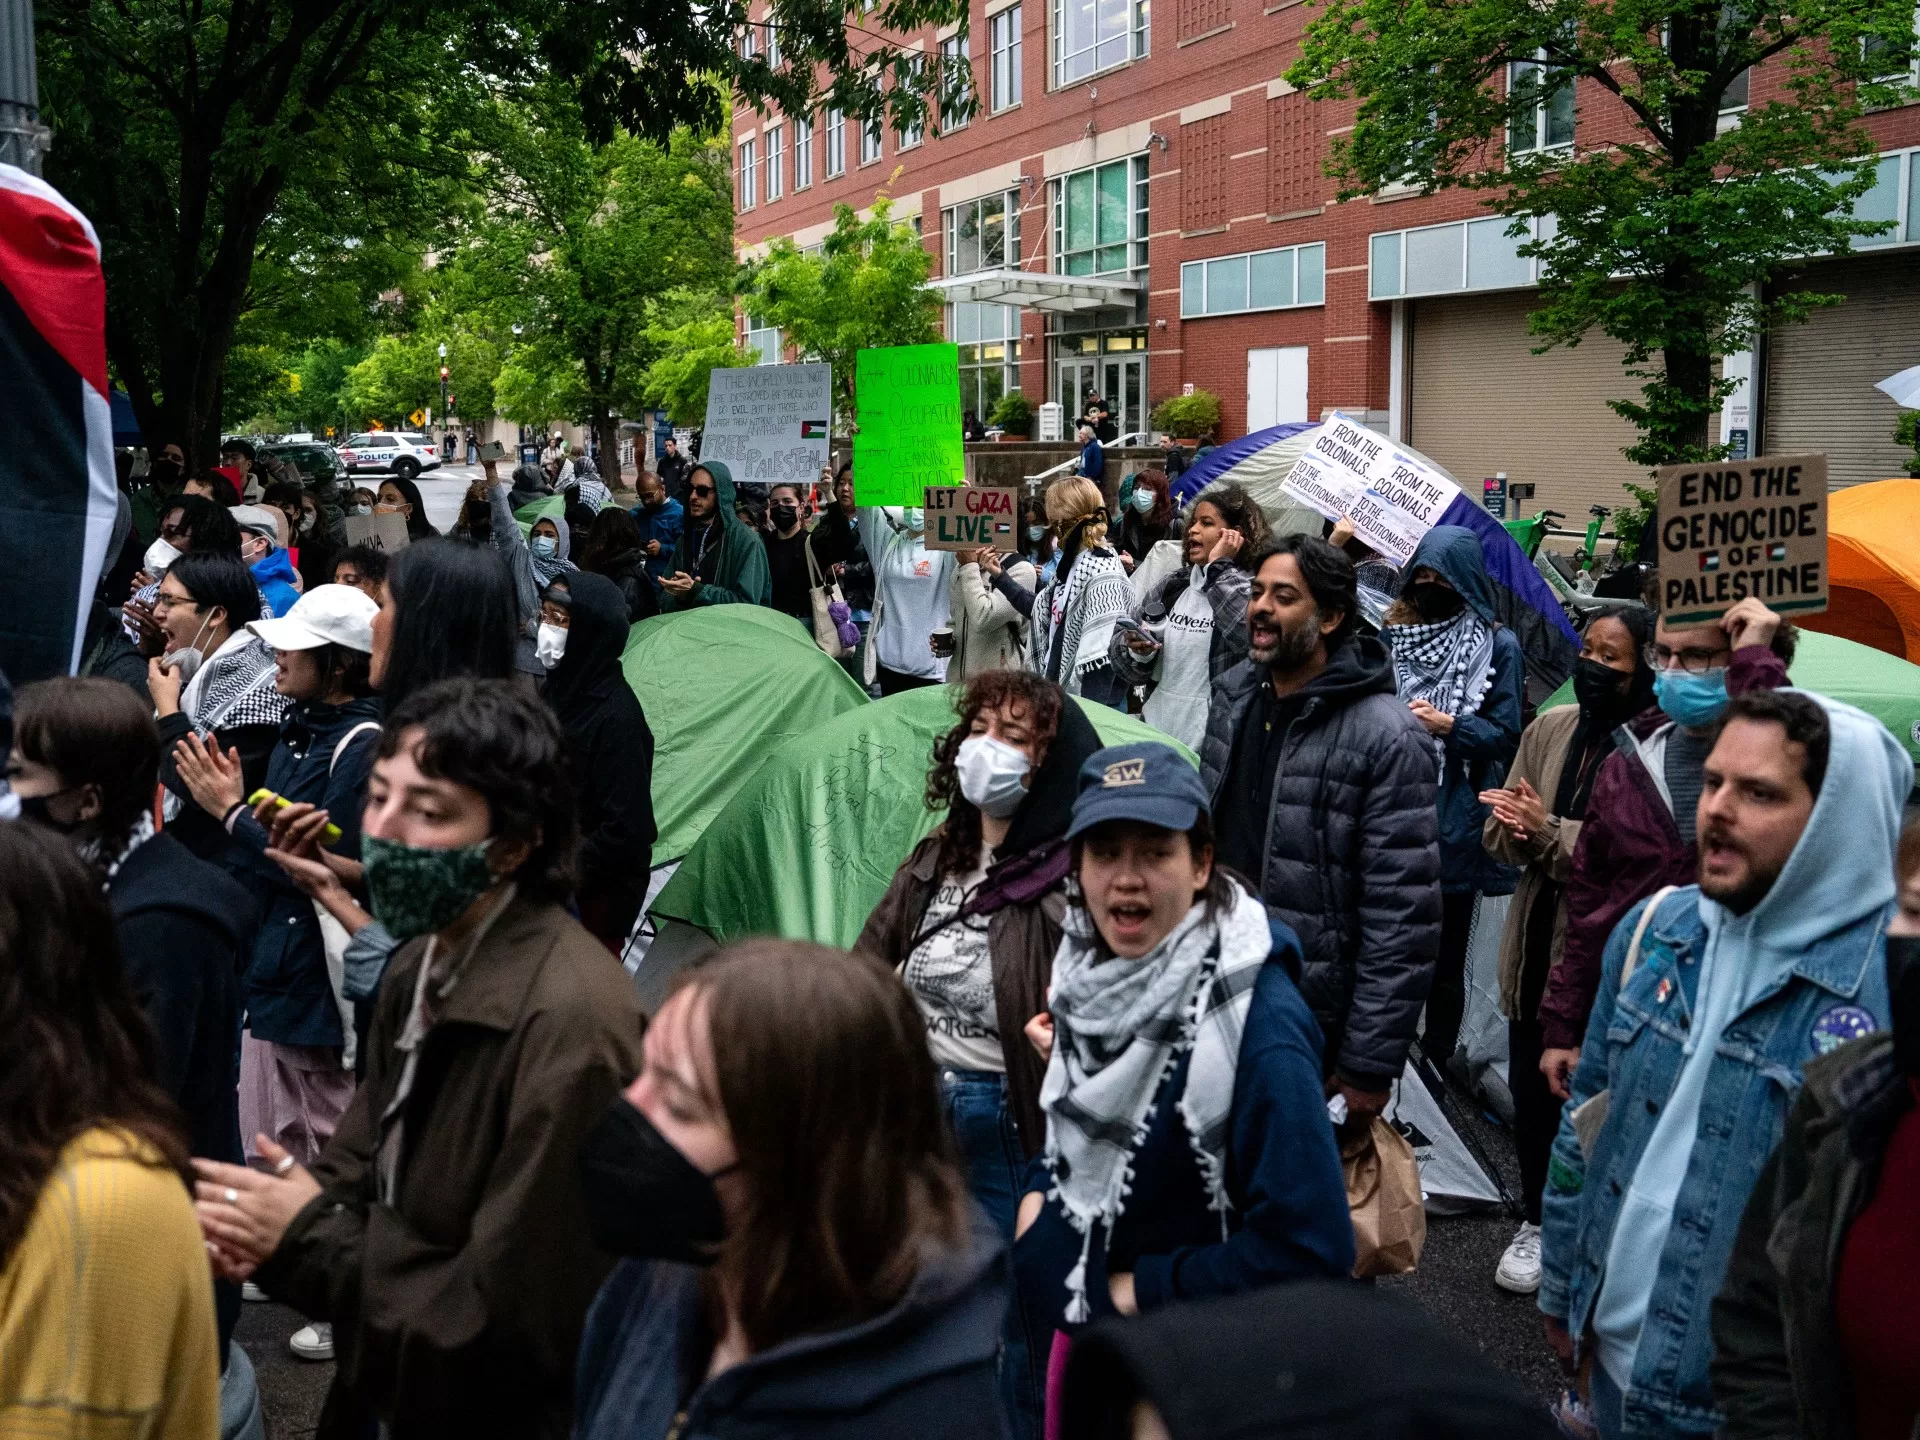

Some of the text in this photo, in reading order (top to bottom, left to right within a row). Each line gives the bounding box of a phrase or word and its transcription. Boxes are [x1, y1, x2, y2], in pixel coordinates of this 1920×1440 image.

[721, 370, 825, 389] THE WORLD WILL NOT
[889, 353, 959, 389] COLONIALISM
[714, 387, 823, 404] BE DESTROYED BY THOSE WHO
[718, 406, 728, 415] DO
[732, 405, 749, 415] EVIL
[751, 405, 766, 415] BUT
[777, 402, 799, 412] THOSE
[802, 401, 818, 411] WHO
[889, 392, 961, 428] OCCUPATION
[748, 425, 787, 436] ANYTHING
[900, 428, 940, 449] ETHNIC
[1332, 423, 1383, 461] FROM THE
[704, 434, 750, 461] FREE
[888, 447, 950, 469] CLEANSING
[744, 447, 828, 480] PALESTIN
[1296, 460, 1308, 473] TO
[1288, 470, 1350, 514] REVOLUTIONARIES
[1391, 465, 1444, 506] FROM THE
[1680, 465, 1801, 507] END THE
[926, 489, 1012, 516] LET GAZA
[1357, 496, 1368, 510] TO
[938, 515, 994, 543] LIVE
[1349, 507, 1414, 556] REVOLUTIONARIES
[1663, 502, 1818, 552] GENOCIDE
[1727, 545, 1761, 566] OF
[1666, 562, 1820, 609] PALESTINE
[1103, 759, 1145, 785] GW
